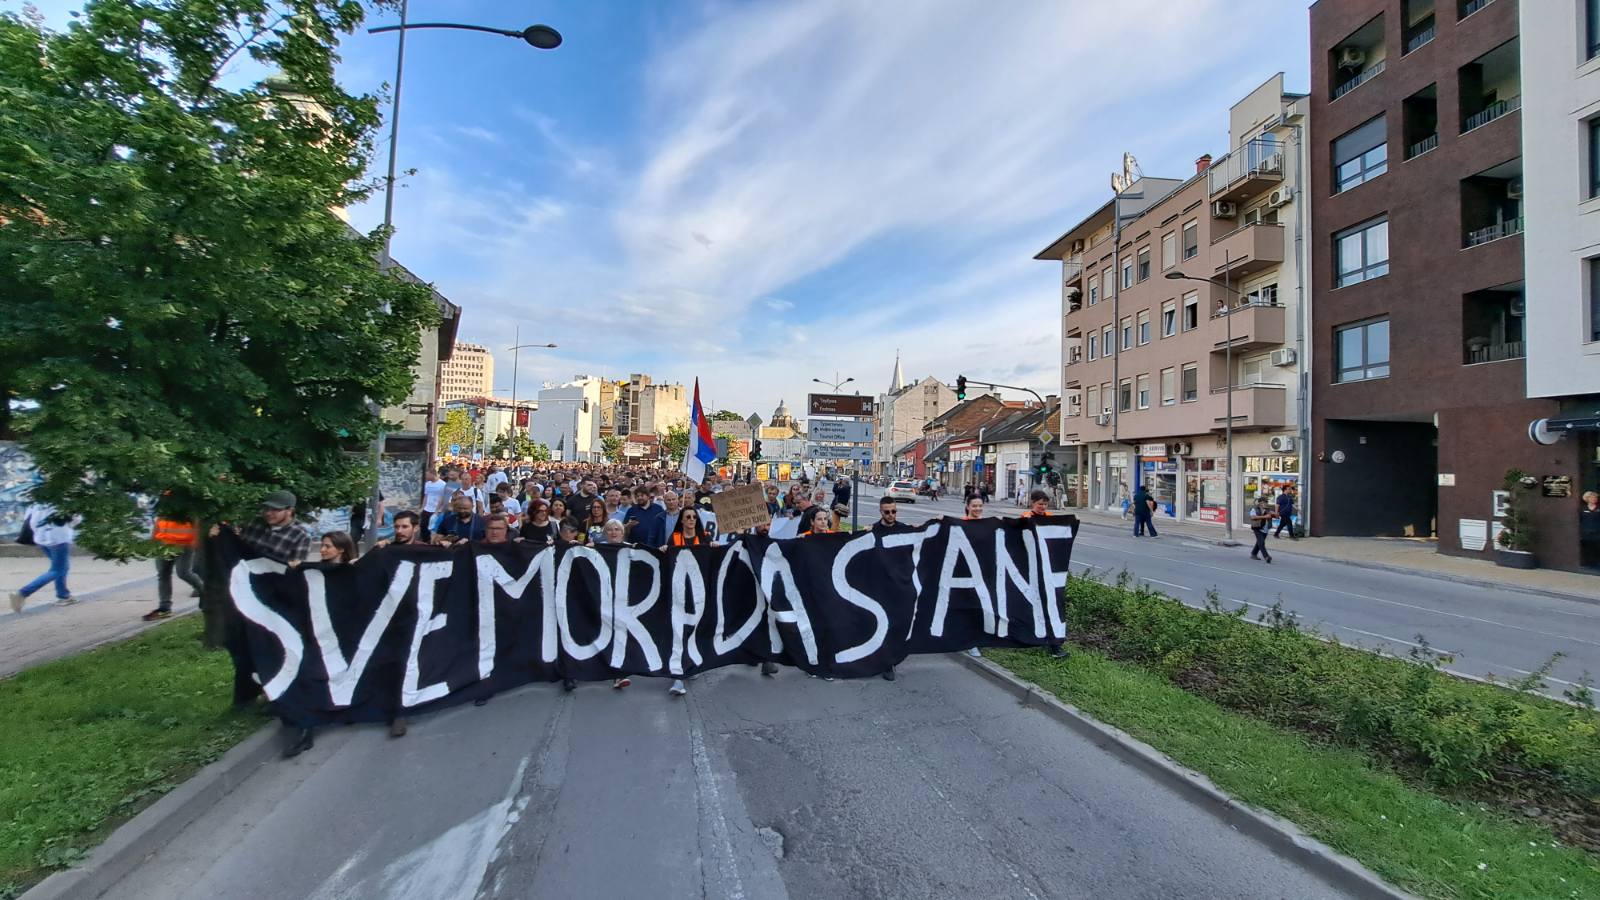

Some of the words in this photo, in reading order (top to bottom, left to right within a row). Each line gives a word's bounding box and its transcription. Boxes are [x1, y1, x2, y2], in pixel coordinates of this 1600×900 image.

[229, 557, 453, 707] SVE
[475, 545, 705, 680] MORA
[713, 540, 818, 666] DA
[831, 523, 1073, 664] STANE
